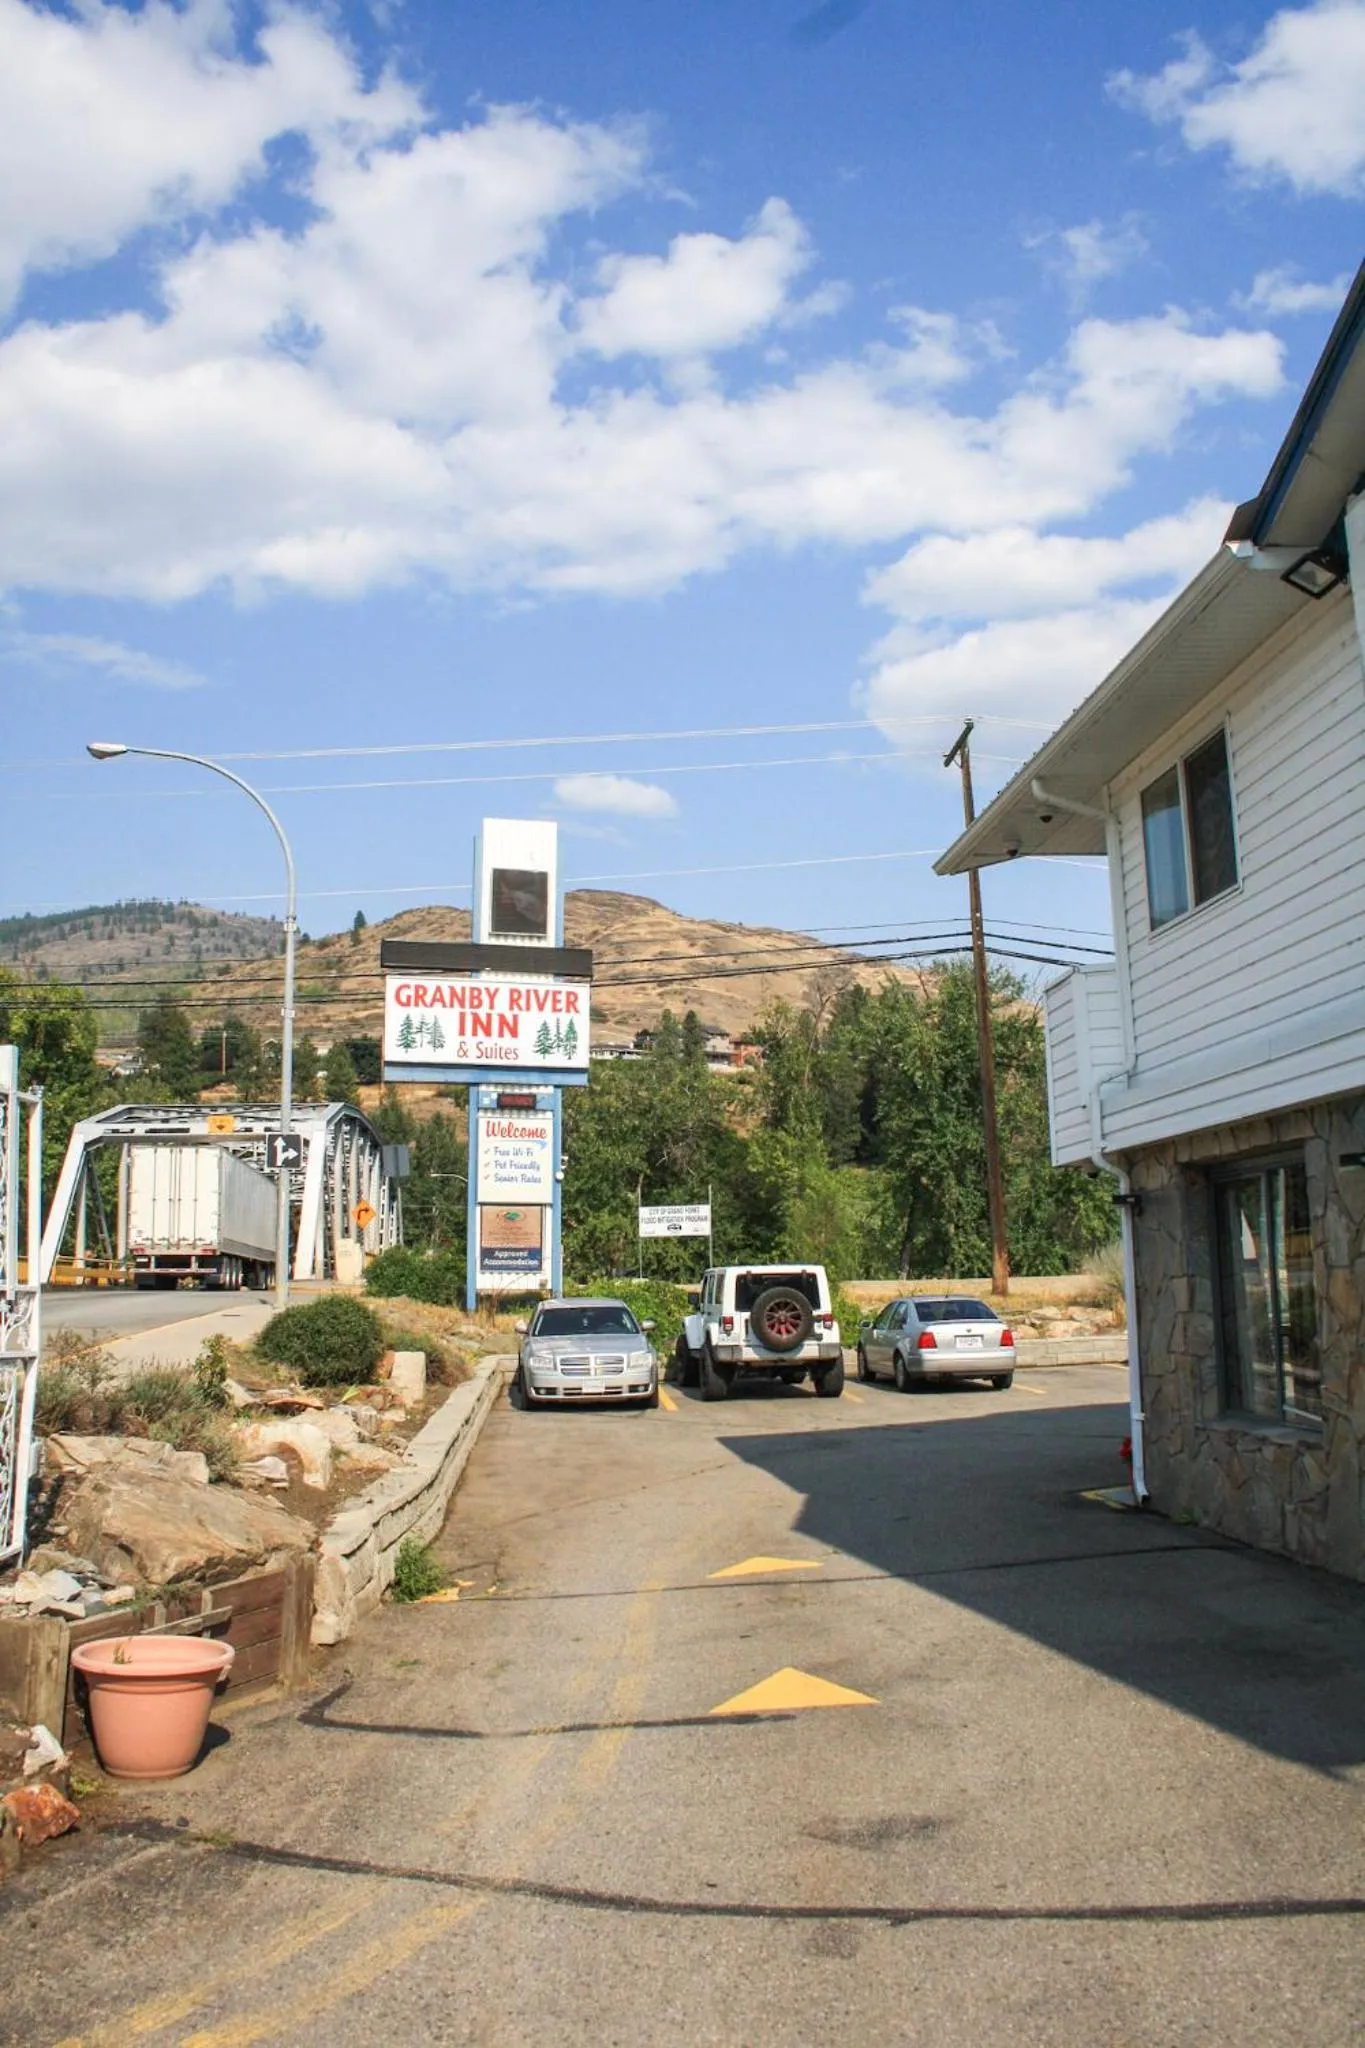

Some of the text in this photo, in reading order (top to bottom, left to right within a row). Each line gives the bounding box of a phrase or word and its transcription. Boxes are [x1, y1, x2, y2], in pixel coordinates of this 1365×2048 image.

[395, 984, 580, 1014] GRANBY RIVER
[458, 1012, 519, 1038] INN
[457, 1042, 520, 1060] & Suites
[486, 1120, 547, 1139] Welcome
[494, 1146, 510, 1156] Free
